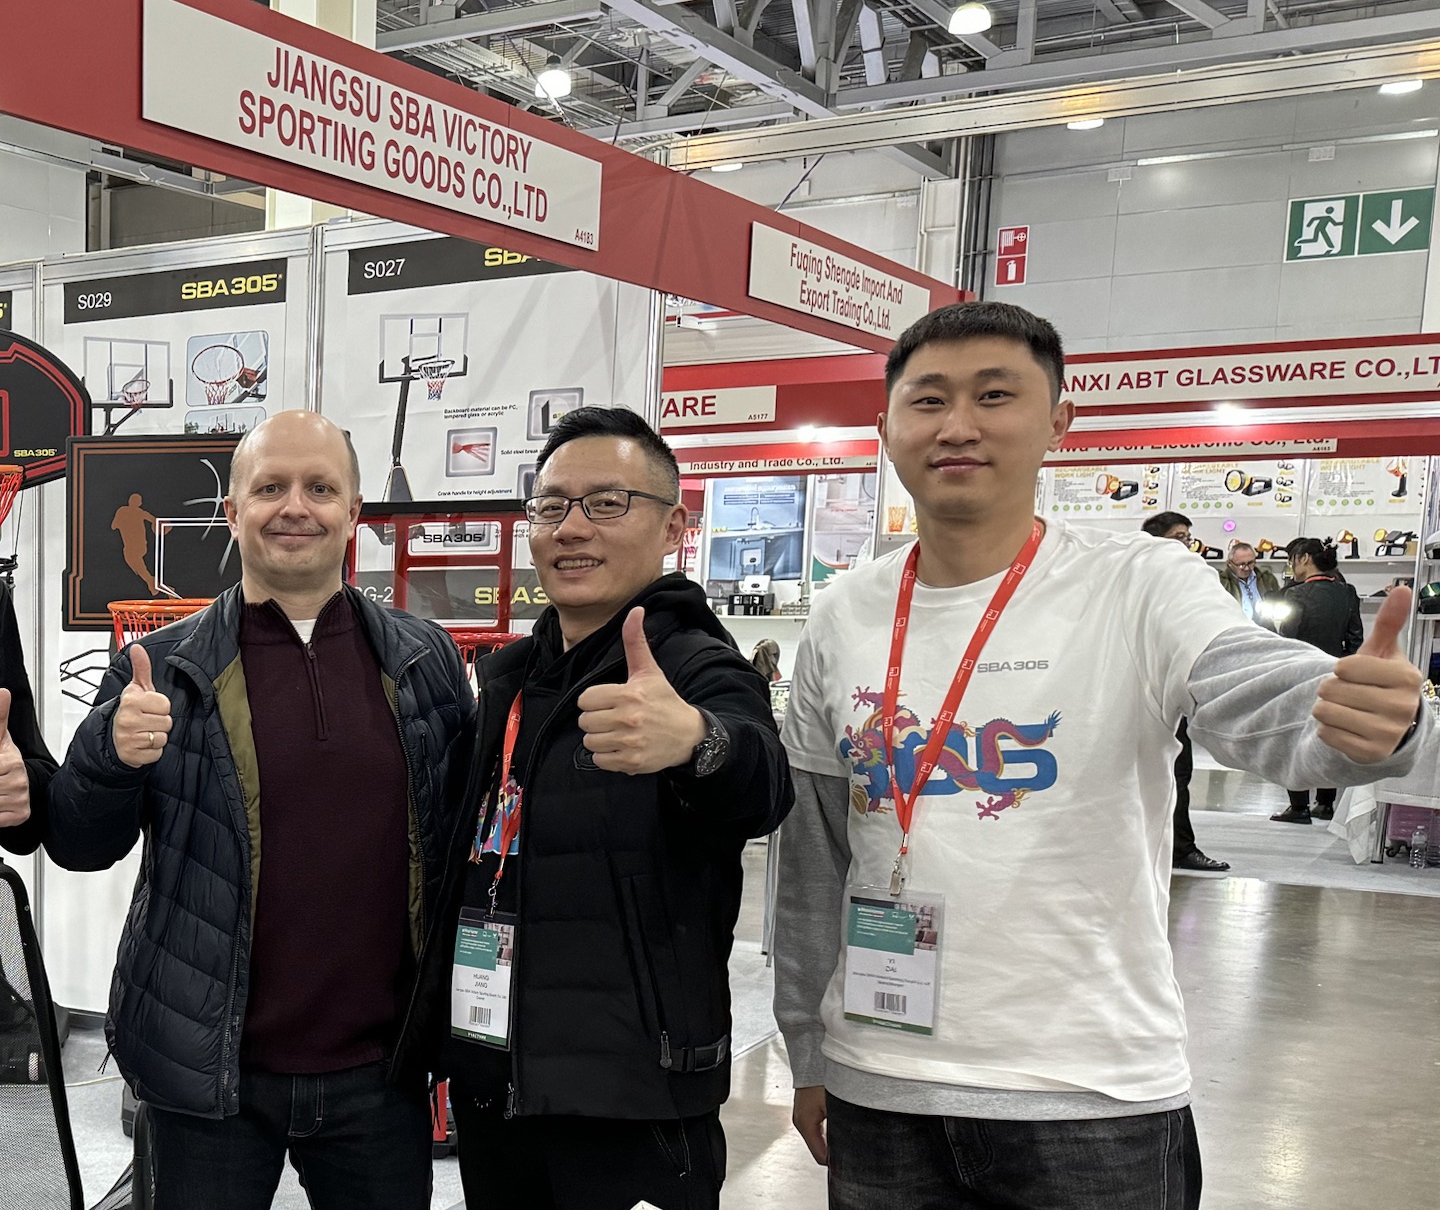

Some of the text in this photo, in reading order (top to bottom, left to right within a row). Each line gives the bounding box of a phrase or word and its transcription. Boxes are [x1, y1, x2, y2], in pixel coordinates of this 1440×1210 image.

[266, 46, 533, 174] JIANGSU SBA VICTORY
[238, 89, 549, 224] SPORTING GOODS CO.,LTD
[573, 228, 595, 246] A4183
[364, 258, 406, 279] S027
[790, 243, 904, 305] Fuqing Shengde Import And
[181, 273, 279, 300] SBA305
[77, 291, 112, 311] S029
[799, 280, 892, 331] Export Trading Co.,Ltd.
[1117, 370, 1168, 390] ABT
[1176, 360, 1346, 388] GLASSWARE
[661, 395, 717, 418] ARE
[748, 413, 768, 421] A5177
[13, 448, 55, 458] SBA305
[690, 461, 734, 471] Industry
[738, 460, 759, 469] and
[423, 533, 483, 543] SBA305
[474, 586, 550, 605] SBA3
[977, 660, 1050, 673] SBA305
